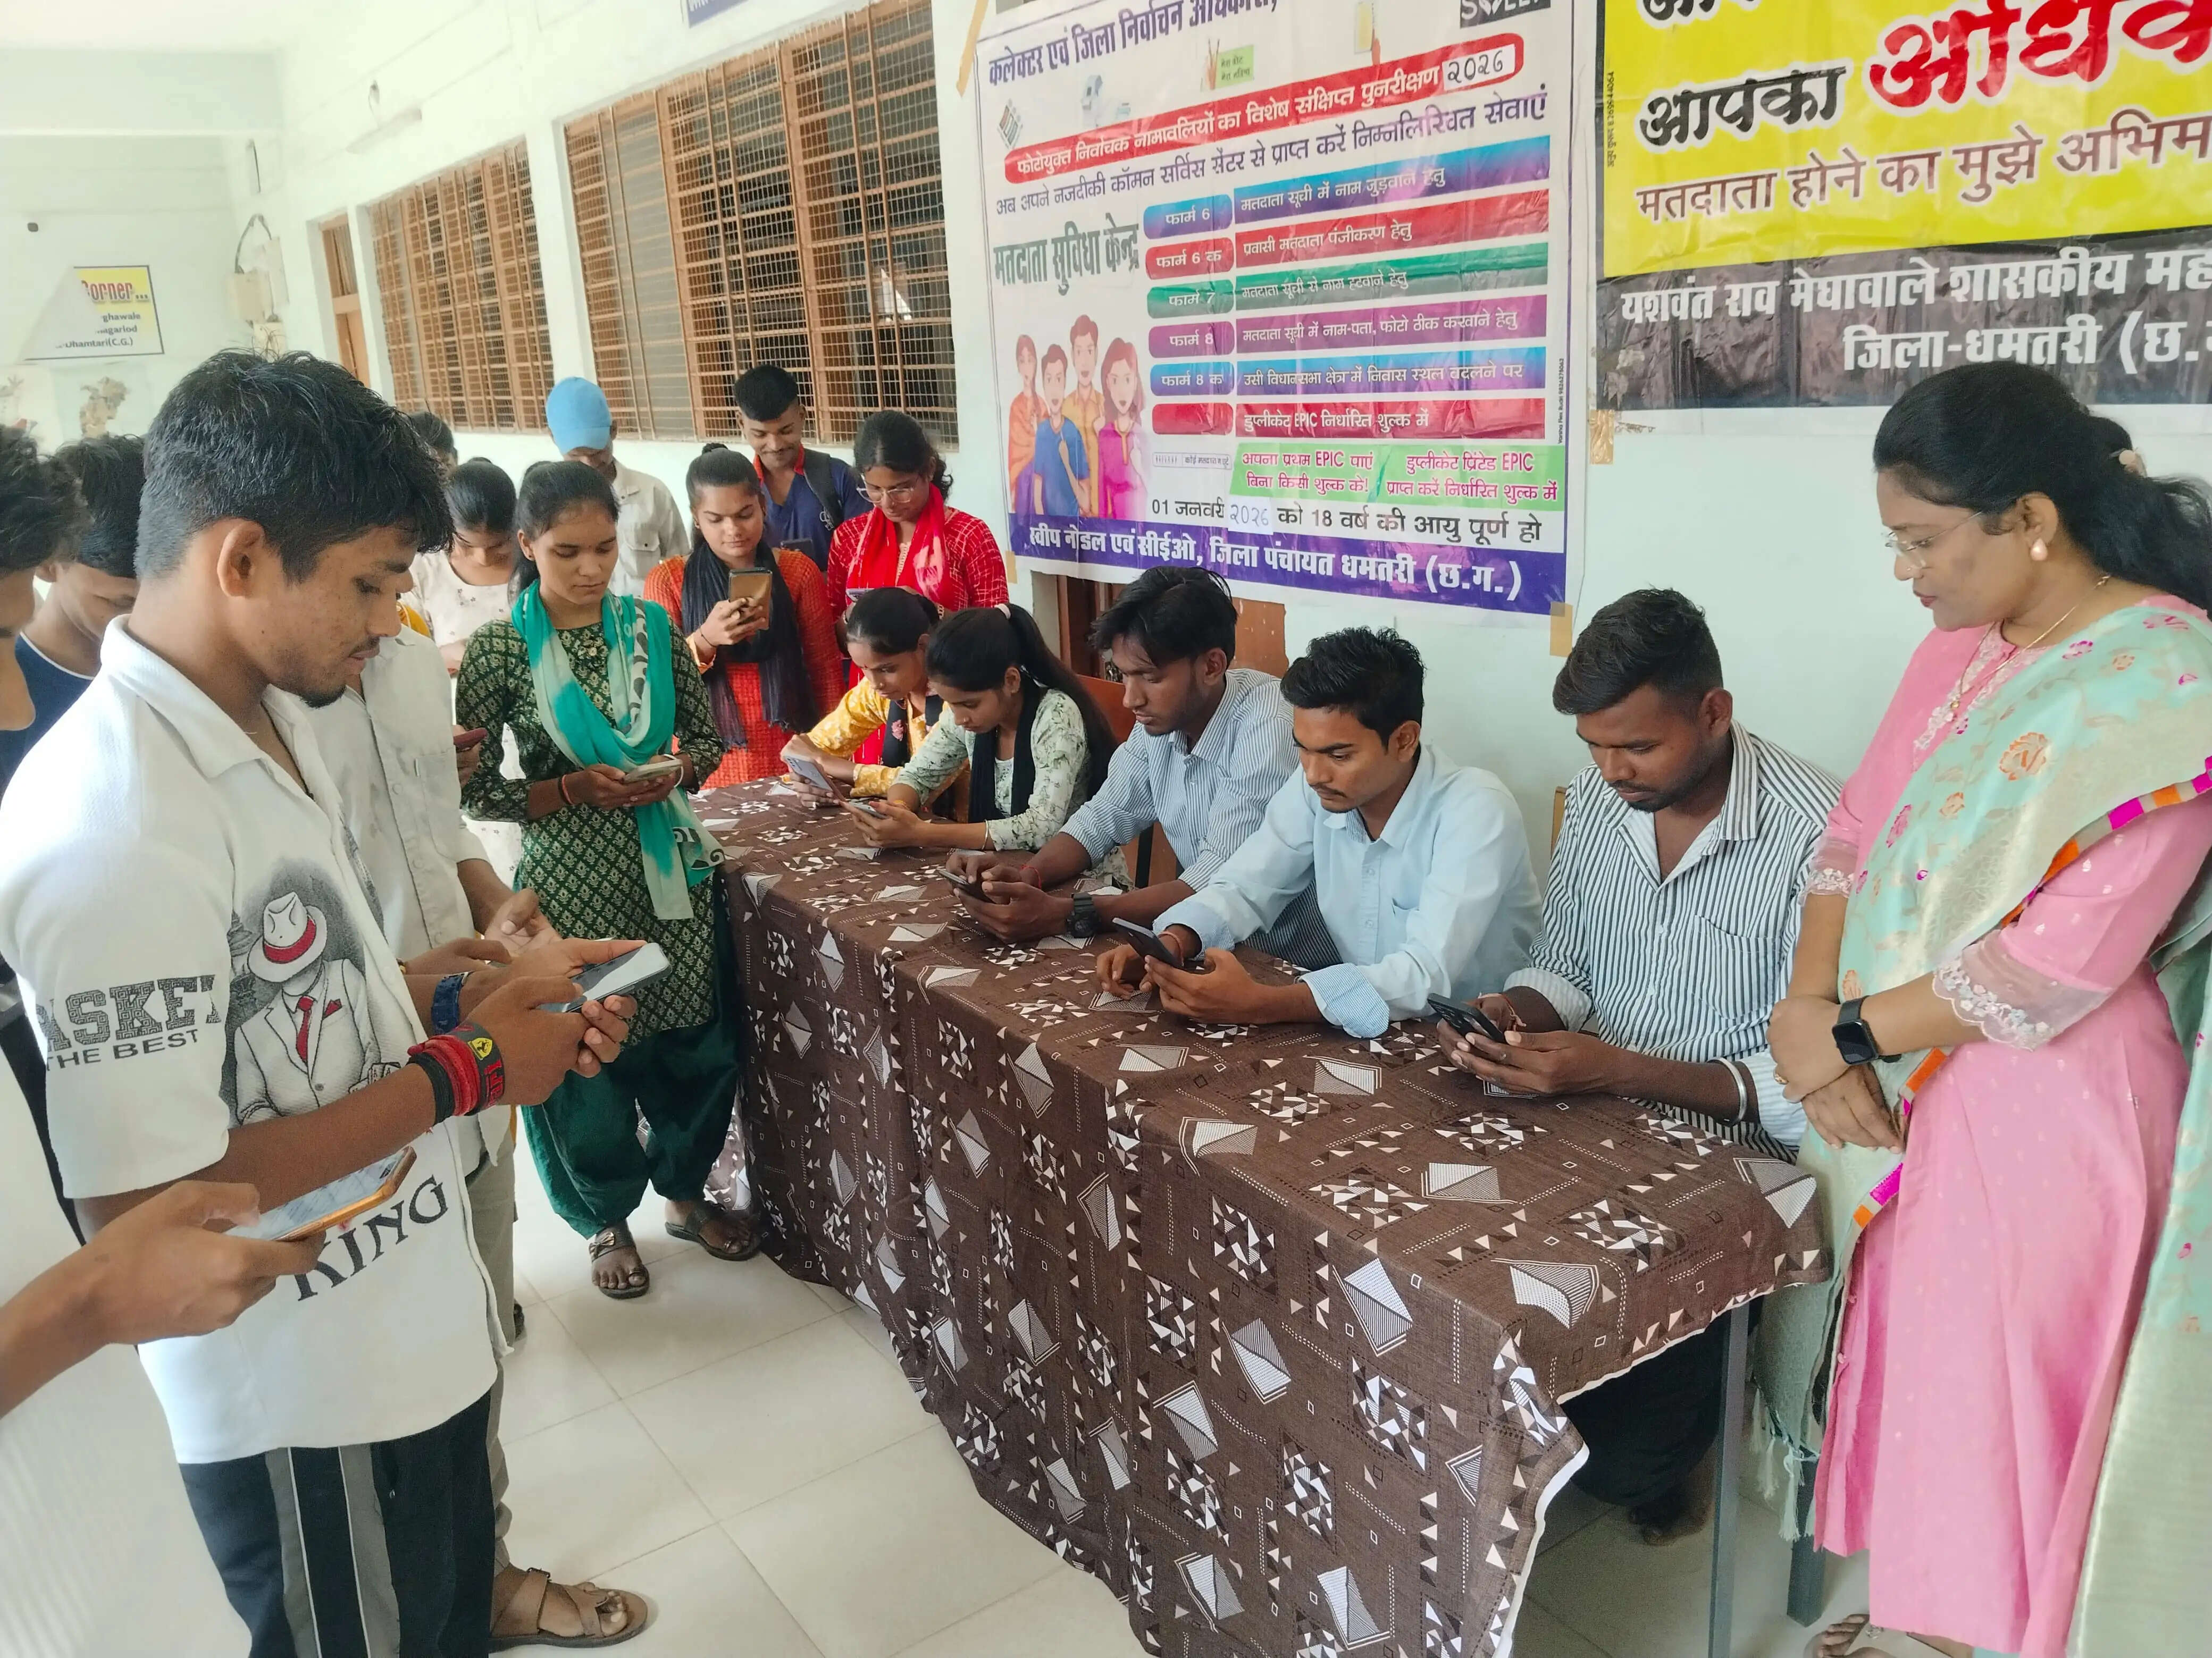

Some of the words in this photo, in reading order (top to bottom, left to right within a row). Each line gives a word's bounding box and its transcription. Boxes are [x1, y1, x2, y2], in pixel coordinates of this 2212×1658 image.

[989, 46, 1043, 86] कलेक्टर
[1048, 29, 1069, 70] एवं
[1071, 22, 1116, 64] जिला
[1119, 0, 1183, 49] निर्वाचन
[1017, 148, 1071, 175] फोटोयुक्त
[1075, 132, 1130, 163] निर्वाचक
[1134, 112, 1216, 149] नामावलियों
[1218, 112, 1241, 131] का
[1246, 96, 1289, 125] विशेष
[1295, 83, 1355, 114] संक्षिप्त
[1361, 65, 1440, 107] पुनरीक्षण
[1639, 66, 1847, 147] आपका
[996, 196, 1016, 215] अब
[1021, 182, 1050, 211] अपने
[1054, 171, 1106, 204] नजदीकी
[1111, 166, 1155, 192] कॉमन
[1161, 152, 1205, 182] सर्विस
[1250, 139, 1266, 166] से
[1272, 138, 1309, 166] प्राप्त
[1316, 124, 1346, 156] करें
[1352, 104, 1476, 150] निम्नलिखित
[1484, 83, 1548, 124] सेवाएं
[1636, 172, 1777, 221] मतदाता
[1787, 148, 1866, 207] होने
[1876, 152, 1941, 193] का
[1953, 124, 2043, 202] मुझे
[1241, 193, 1284, 212] मतदाता
[1288, 184, 1313, 209] सूची
[1317, 181, 1330, 199] में
[1335, 181, 1362, 197] नाम
[1166, 205, 1196, 225] फार्म
[1202, 208, 1210, 221] 6
[1243, 235, 1275, 256] प्रवासी
[1279, 232, 1324, 251] मतदाता
[1328, 224, 1386, 245] पंजीकरण
[1390, 218, 1413, 241] हेतु
[994, 239, 1048, 287] मतदाता
[1051, 221, 1101, 296] सुविधा
[1104, 212, 1139, 273] केन्द्र
[1157, 249, 1187, 268] फार्म
[1192, 251, 1201, 264] 6
[1206, 249, 1222, 265] क
[1168, 289, 1201, 307] फार्म
[1206, 292, 1216, 305] 7
[1242, 284, 1279, 299] मतदाता
[1282, 276, 1304, 300] सूची
[1309, 276, 1319, 293] से
[1322, 278, 1345, 291] नाम
[1349, 270, 1384, 291] हटवाने
[1389, 268, 1408, 290] हेतु
[1621, 276, 1716, 323] यशवंत
[1724, 281, 1780, 317] राव
[1790, 257, 1939, 313] मेघावाले
[1950, 247, 2133, 302] शासकीय
[2145, 248, 2212, 292] मह
[1170, 330, 1200, 347] फार्म
[1205, 333, 1213, 344] 8
[1243, 328, 1281, 341] मतदाता
[1284, 323, 1304, 343] सूची
[1308, 321, 1319, 338] में
[1322, 321, 1376, 336] नाम-पता,
[1380, 315, 1409, 334] फोटो
[1413, 313, 1439, 332] ठीक
[1443, 308, 1490, 330] करवाने
[1495, 307, 1518, 330] हेतु
[1842, 313, 2102, 372] जिला-धमतरी
[2120, 311, 2212, 374] (छ.
[1161, 370, 1191, 386] फार्म
[1196, 374, 1204, 385] 8
[1209, 374, 1224, 385] क
[1244, 369, 1264, 385] उसी
[1267, 368, 1322, 385] विधानसभा
[1326, 367, 1346, 385] क्षेत्र
[1350, 365, 1362, 383] में
[1367, 365, 1407, 383] निवास
[1411, 367, 1444, 381] स्थल
[1450, 360, 1497, 380] बदलने
[1503, 364, 1523, 379] पर
[1244, 410, 1292, 432] डुप्लीकेट
[1294, 414, 1317, 427] EPIC
[1321, 408, 1372, 428] निर्धारित
[1377, 413, 1412, 432] शुल्क
[1415, 408, 1429, 426] में
[1243, 452, 1278, 465] अपना
[1283, 454, 1310, 467] प्रथम
[1316, 451, 1345, 467] EPIC
[1350, 451, 1373, 469] पाएं
[1406, 451, 1459, 474] डुप्लीकेट
[1462, 452, 1497, 471] प्रिंटेड
[1502, 452, 1534, 472] EPIC
[1247, 472, 1273, 488] बिना
[1278, 473, 1309, 489] किसी
[1314, 478, 1345, 495] शुल्क
[1387, 482, 1414, 495] प्राप्त
[1418, 477, 1440, 496] करें
[1445, 478, 1497, 498] निर्धारित
[1504, 485, 1538, 504] शुल्क
[1543, 481, 1558, 500] में
[1152, 499, 1168, 515] 01
[1277, 501, 1303, 525] को
[1312, 510, 1332, 527] 18
[1340, 505, 1369, 530] वर्ष
[1376, 507, 1406, 532] की
[1414, 516, 1462, 543] आयु
[1468, 511, 1509, 545] पूर्ण
[1518, 513, 1542, 543] हो
[1029, 523, 1061, 548] स्वीप
[1064, 524, 1107, 552] नोडल
[1110, 528, 1136, 554] एवं
[1137, 531, 1203, 566] सीईओ,
[1208, 536, 1259, 567] जिला
[1264, 539, 1336, 576] पंचायत
[1341, 553, 1417, 584] धमतरी
[1426, 555, 1522, 601] (छ.ग.)
[113, 1029, 198, 1059] BEST
